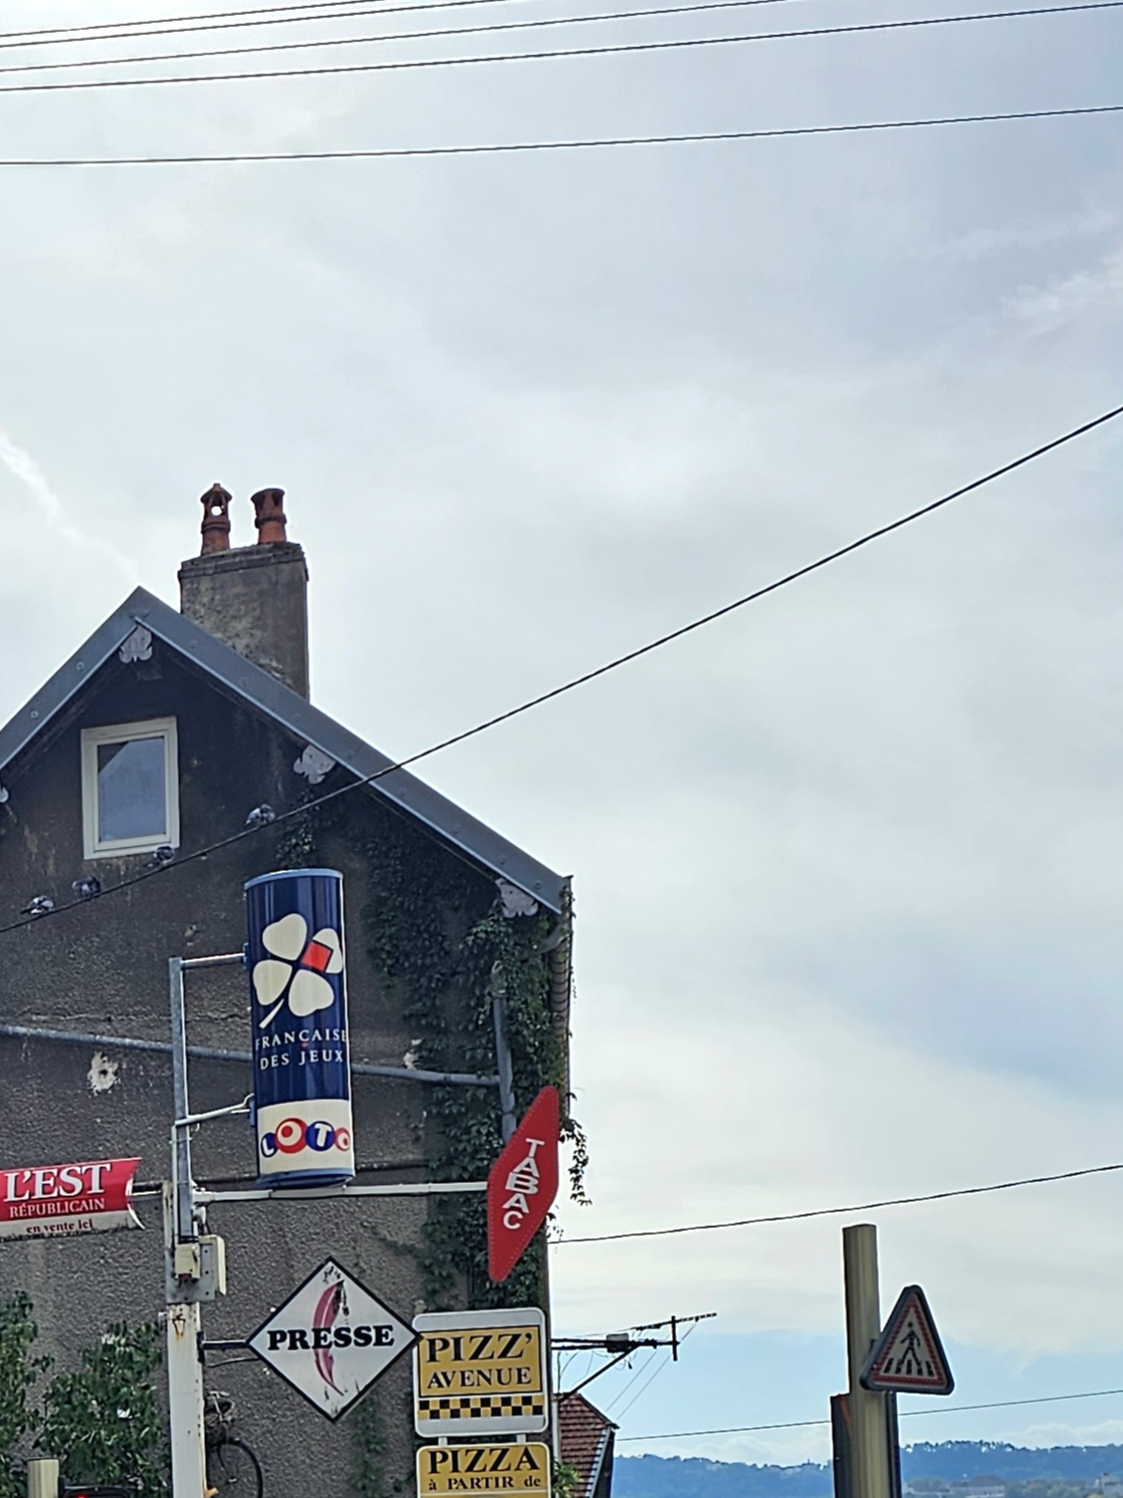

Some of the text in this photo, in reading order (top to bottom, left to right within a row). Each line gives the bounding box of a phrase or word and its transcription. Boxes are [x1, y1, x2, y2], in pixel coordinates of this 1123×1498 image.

[260, 1050, 344, 1070] DES JEUX
[260, 1117, 351, 1158] LOTO
[3, 1163, 111, 1202] L'EST
[501, 1137, 546, 1230] TABAC
[9, 1198, 105, 1218] RÉPUBLICAIN
[267, 1325, 395, 1351] PRESSE
[426, 1333, 533, 1363] PIZZ'
[427, 1367, 532, 1389] AVENUE
[428, 1446, 540, 1475] PIZZA
[428, 1474, 541, 1491] à PARTIR de
